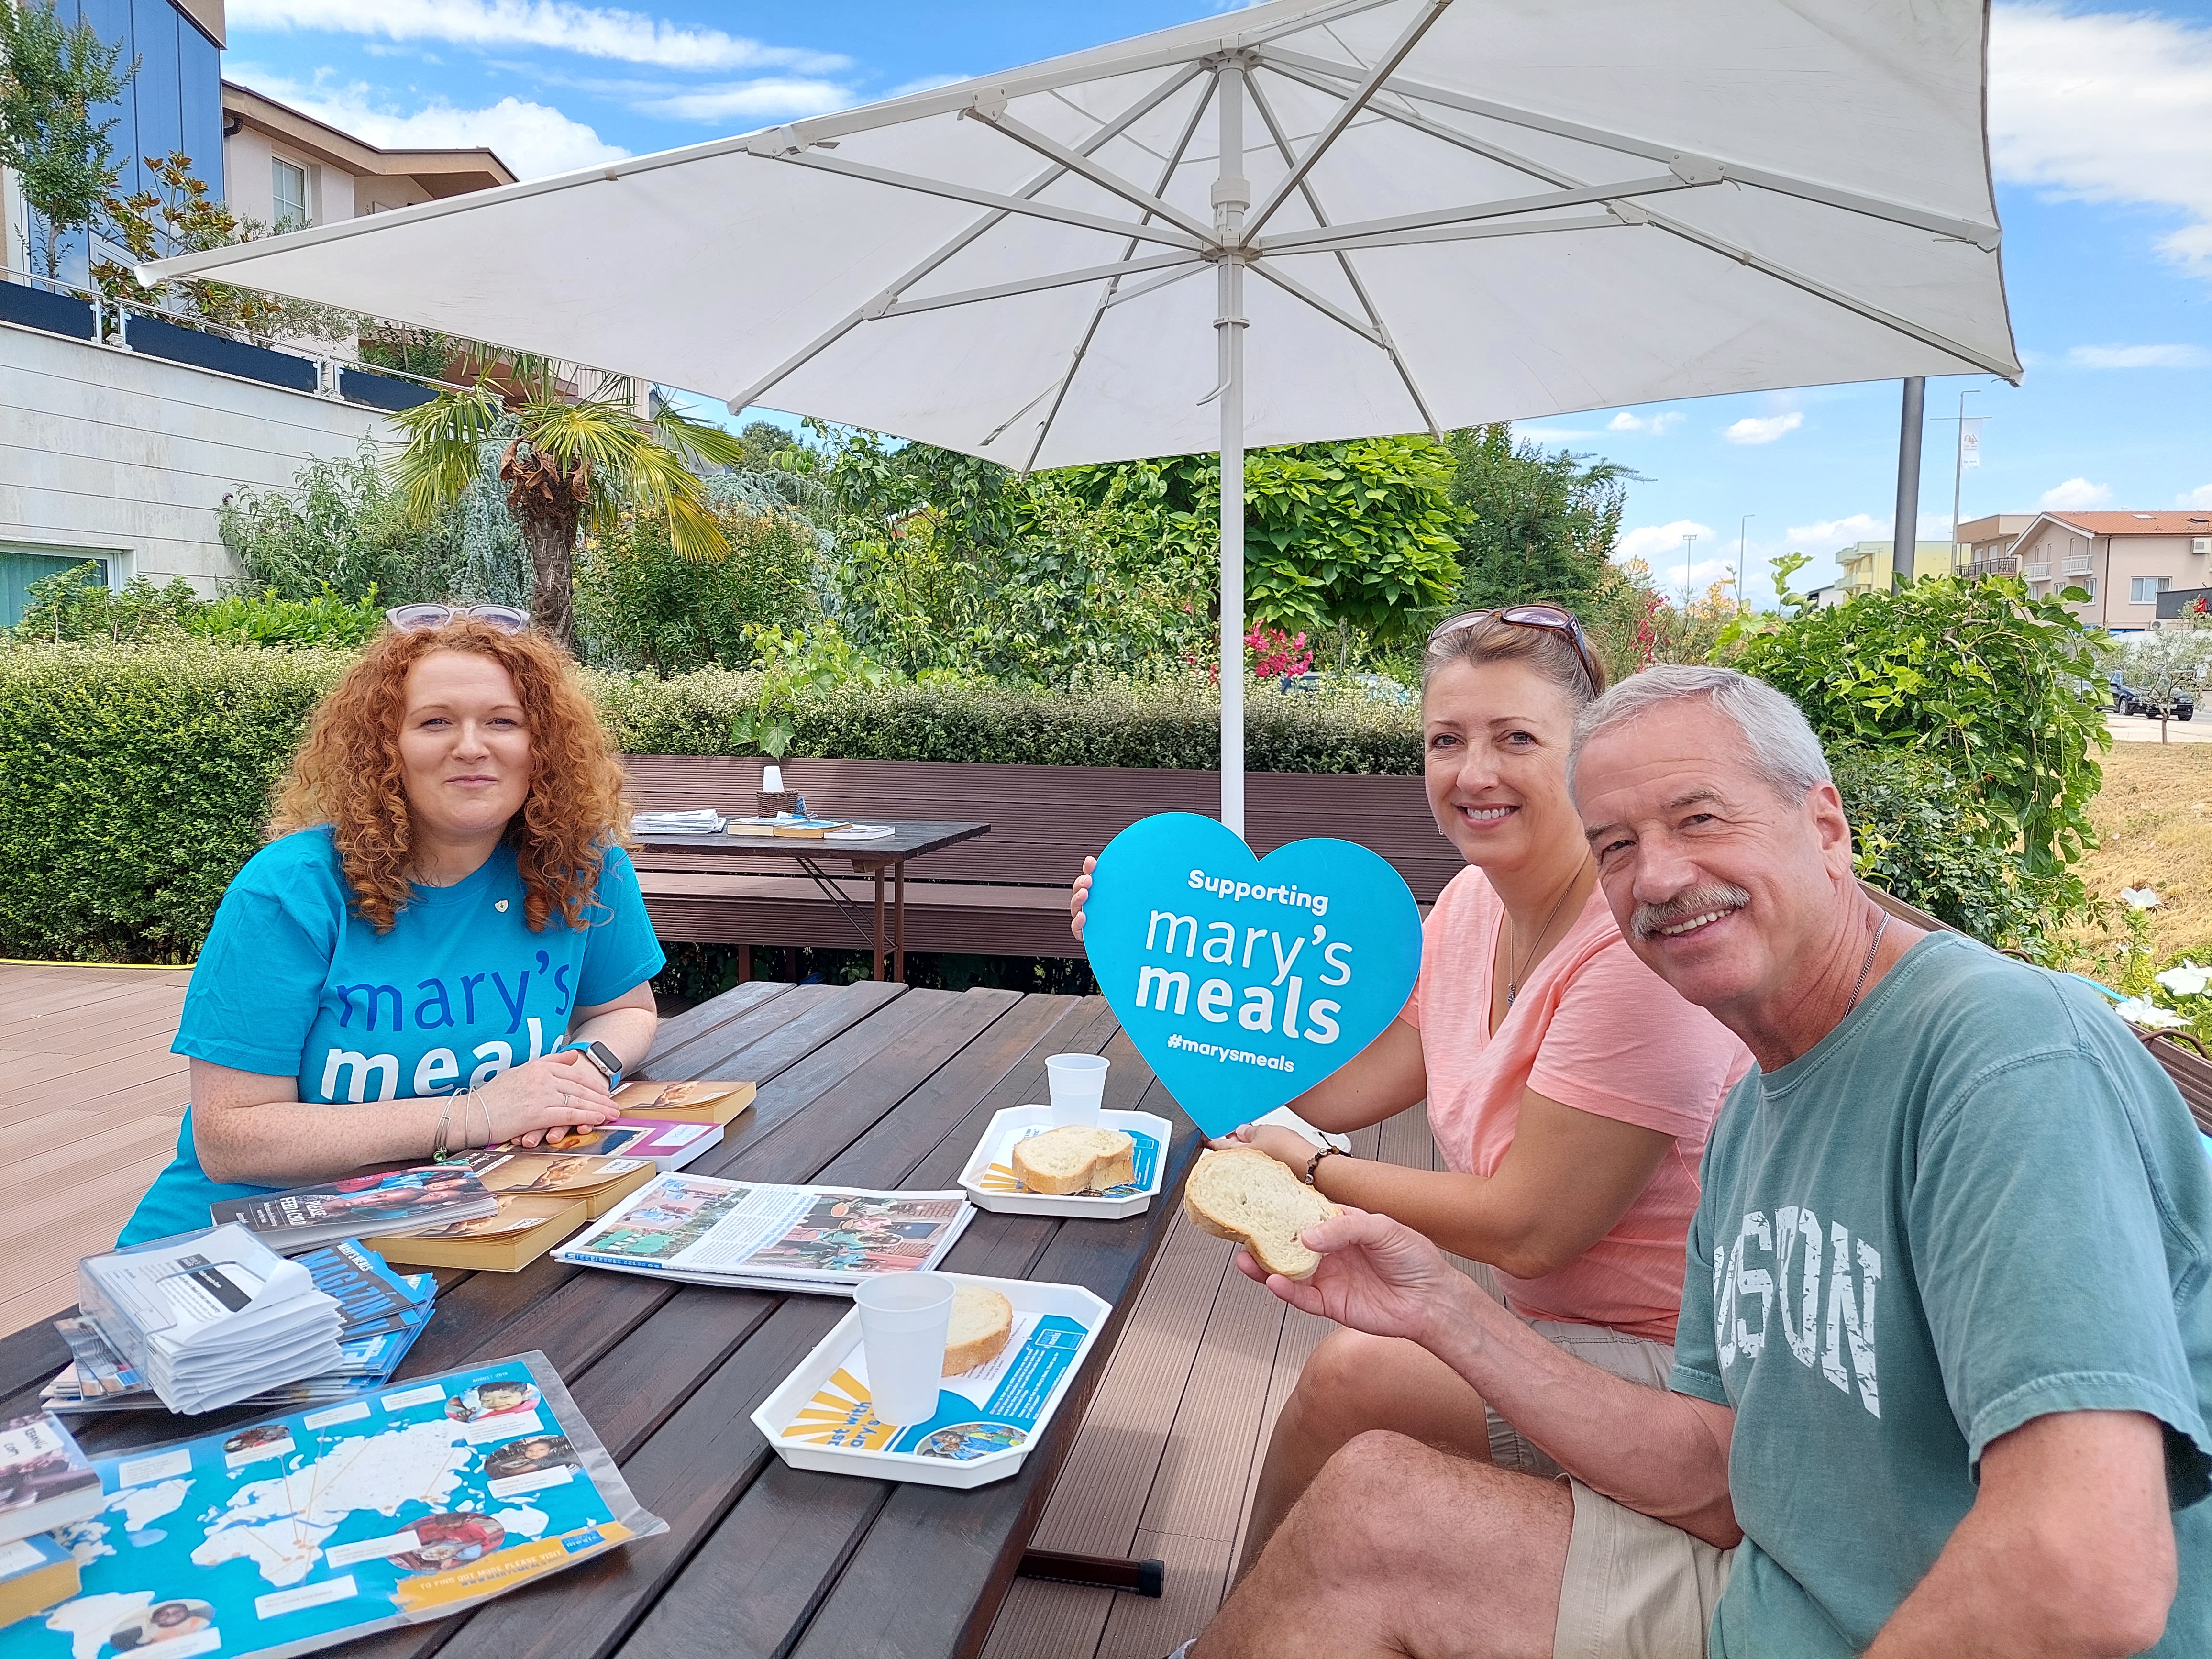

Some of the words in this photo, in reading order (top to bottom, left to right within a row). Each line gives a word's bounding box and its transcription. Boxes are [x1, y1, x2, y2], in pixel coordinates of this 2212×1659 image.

[1188, 869, 1328, 916] Supporting
[1145, 909, 1353, 987] mary's
[337, 950, 570, 1034] mary's
[1135, 965, 1342, 1045] meals
[1167, 1033, 1295, 1073] #marysmeals
[280, 1196, 299, 1210] FEED
[287, 1212, 307, 1225] CHILD
[305, 1200, 328, 1218] PLEASE,
[336, 1243, 358, 1259] MARY'S
[352, 1254, 373, 1271] MEALS
[294, 1249, 397, 1319] MAGAZÍN
[1049, 1332, 1061, 1345] meals
[843, 1402, 872, 1426] with
[420, 1582, 431, 1591] TO
[434, 1577, 454, 1588] FIND
[457, 1573, 475, 1583] OUT
[477, 1565, 503, 1578] MORE
[504, 1556, 539, 1572] PLEASE
[540, 1549, 562, 1561] VISIT
